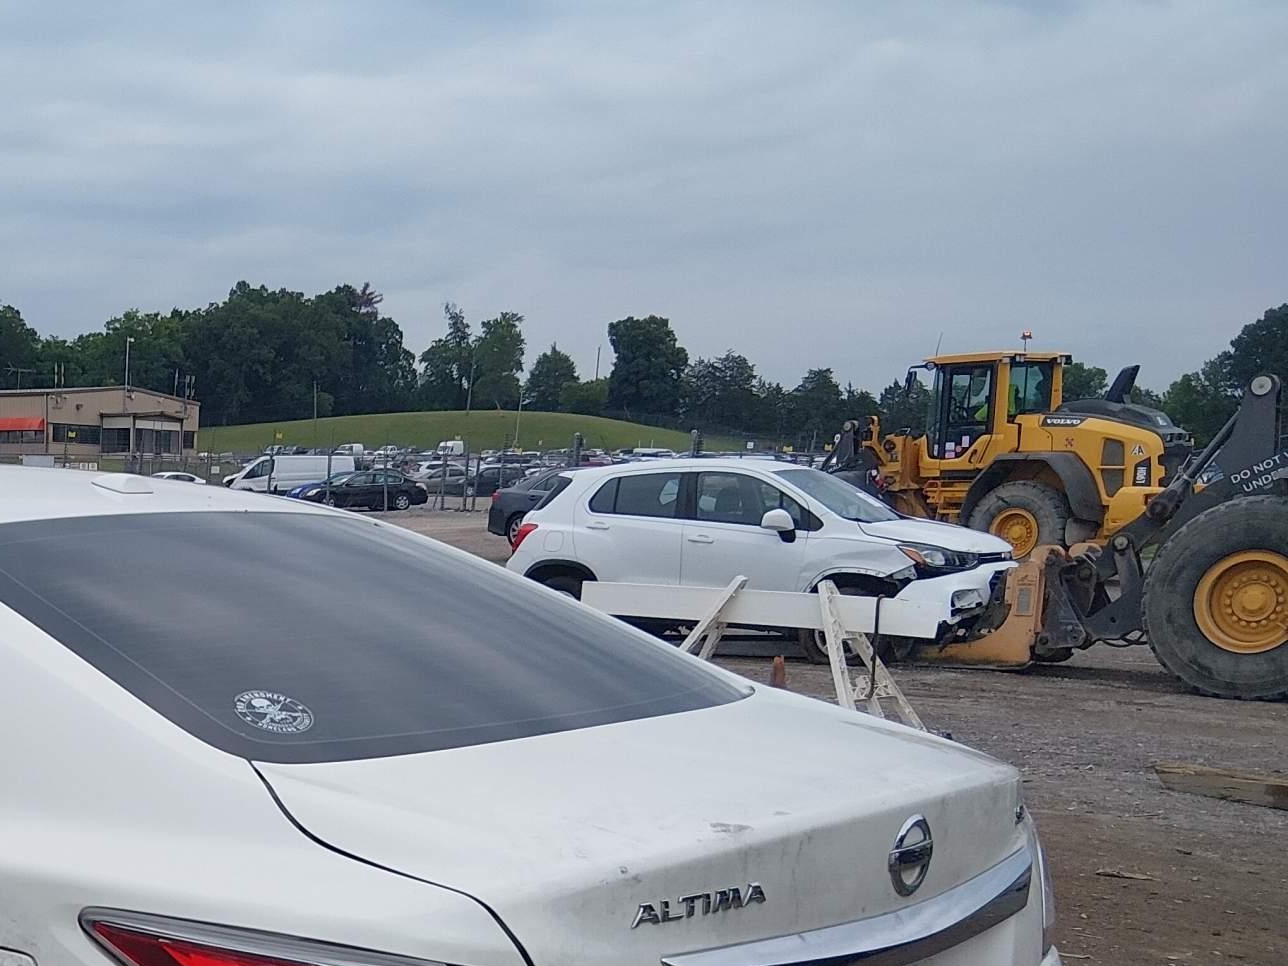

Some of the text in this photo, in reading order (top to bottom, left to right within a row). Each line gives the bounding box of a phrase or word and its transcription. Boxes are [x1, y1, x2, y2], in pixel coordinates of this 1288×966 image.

[1046, 417, 1081, 426] VOLVO
[1230, 469, 1251, 484] DO
[1252, 454, 1281, 475] NOT
[631, 881, 767, 929] ALTIMA
